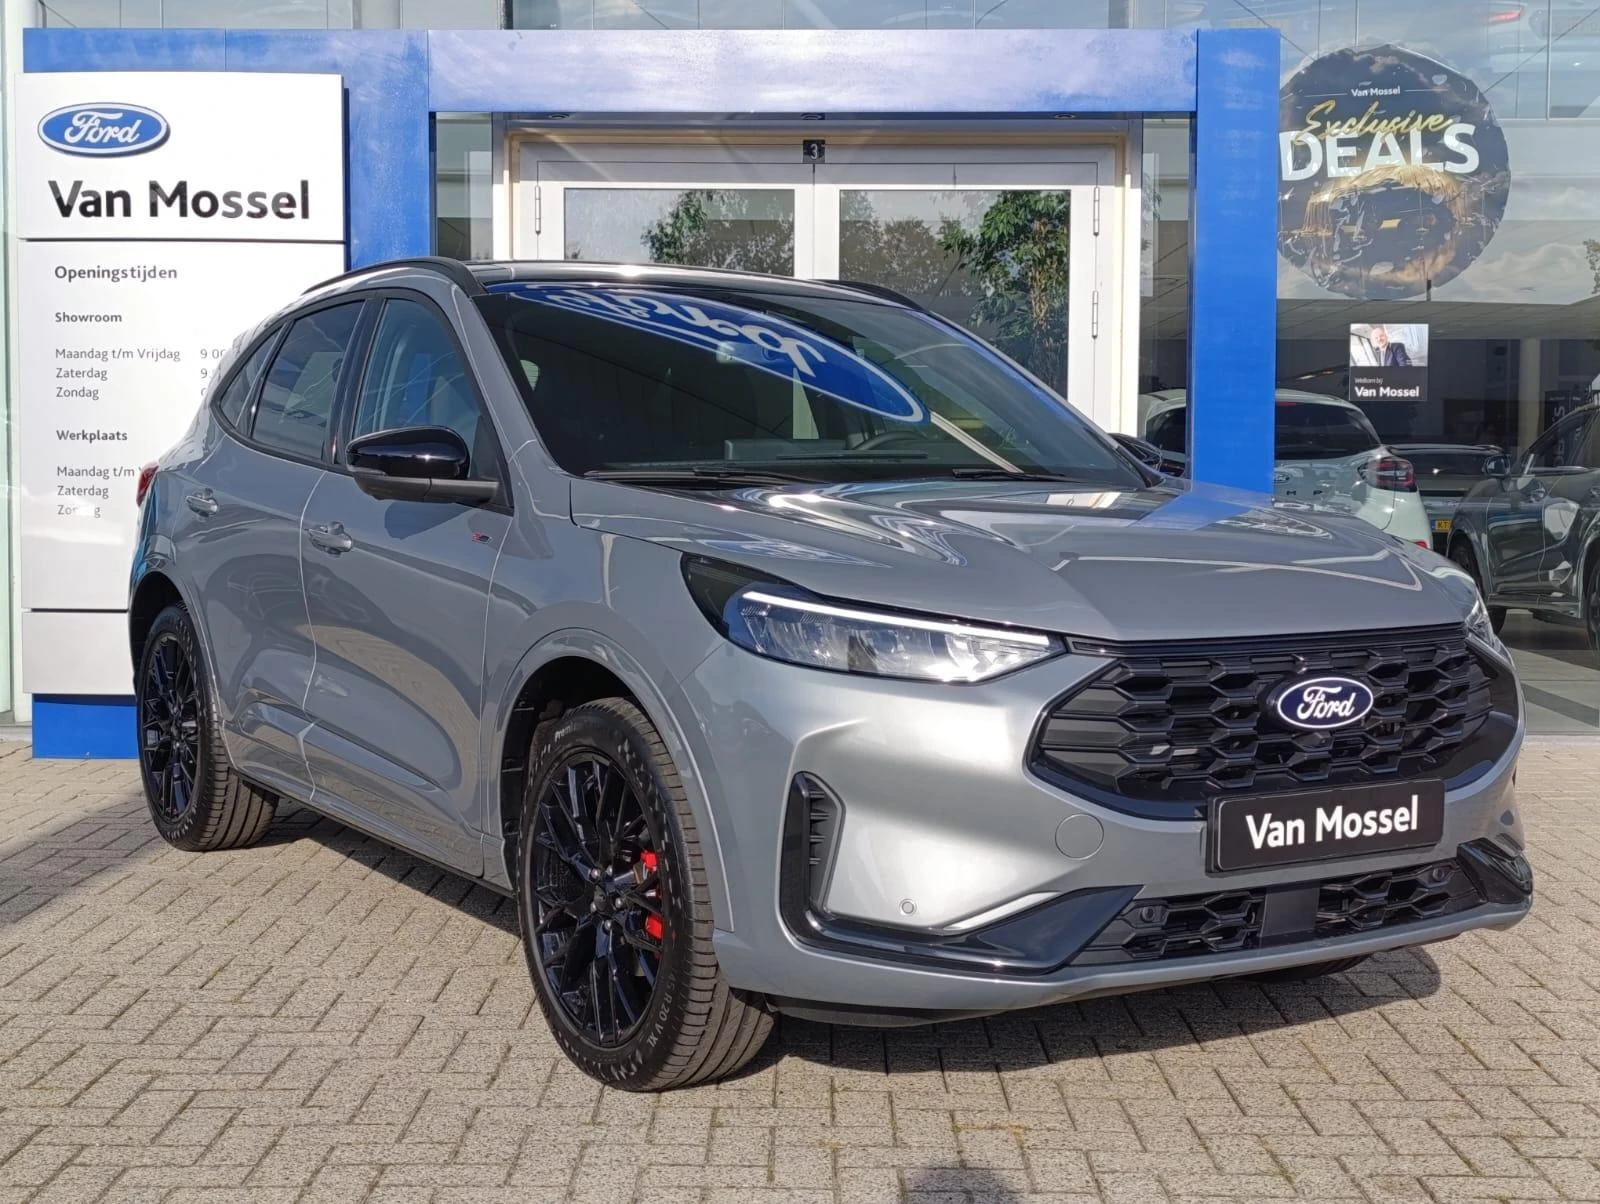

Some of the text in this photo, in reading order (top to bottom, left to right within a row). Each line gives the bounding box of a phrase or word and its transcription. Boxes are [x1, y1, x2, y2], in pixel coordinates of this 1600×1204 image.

[1350, 86, 1401, 97] Van Mossel
[64, 111, 142, 143] Ford
[1294, 99, 1454, 145] Exclusive
[810, 143, 818, 160] 3
[1279, 123, 1480, 181] DEALS
[48, 179, 309, 219] Van Mossel
[54, 265, 178, 283] Openingstijden
[55, 311, 122, 323] Showroom
[55, 348, 108, 362] Maandag
[112, 348, 134, 359] t/m
[137, 348, 181, 362] Vrijdag
[55, 368, 108, 381] Zaterdag
[55, 387, 100, 400] Zondag
[1354, 386, 1420, 398] Van Mossel
[56, 429, 128, 443] Werkplaats
[56, 466, 135, 480] Maandag t/m
[57, 485, 109, 499] Zaterdag
[1296, 686, 1356, 720] Ford
[1245, 795, 1418, 849] Van Mossel
